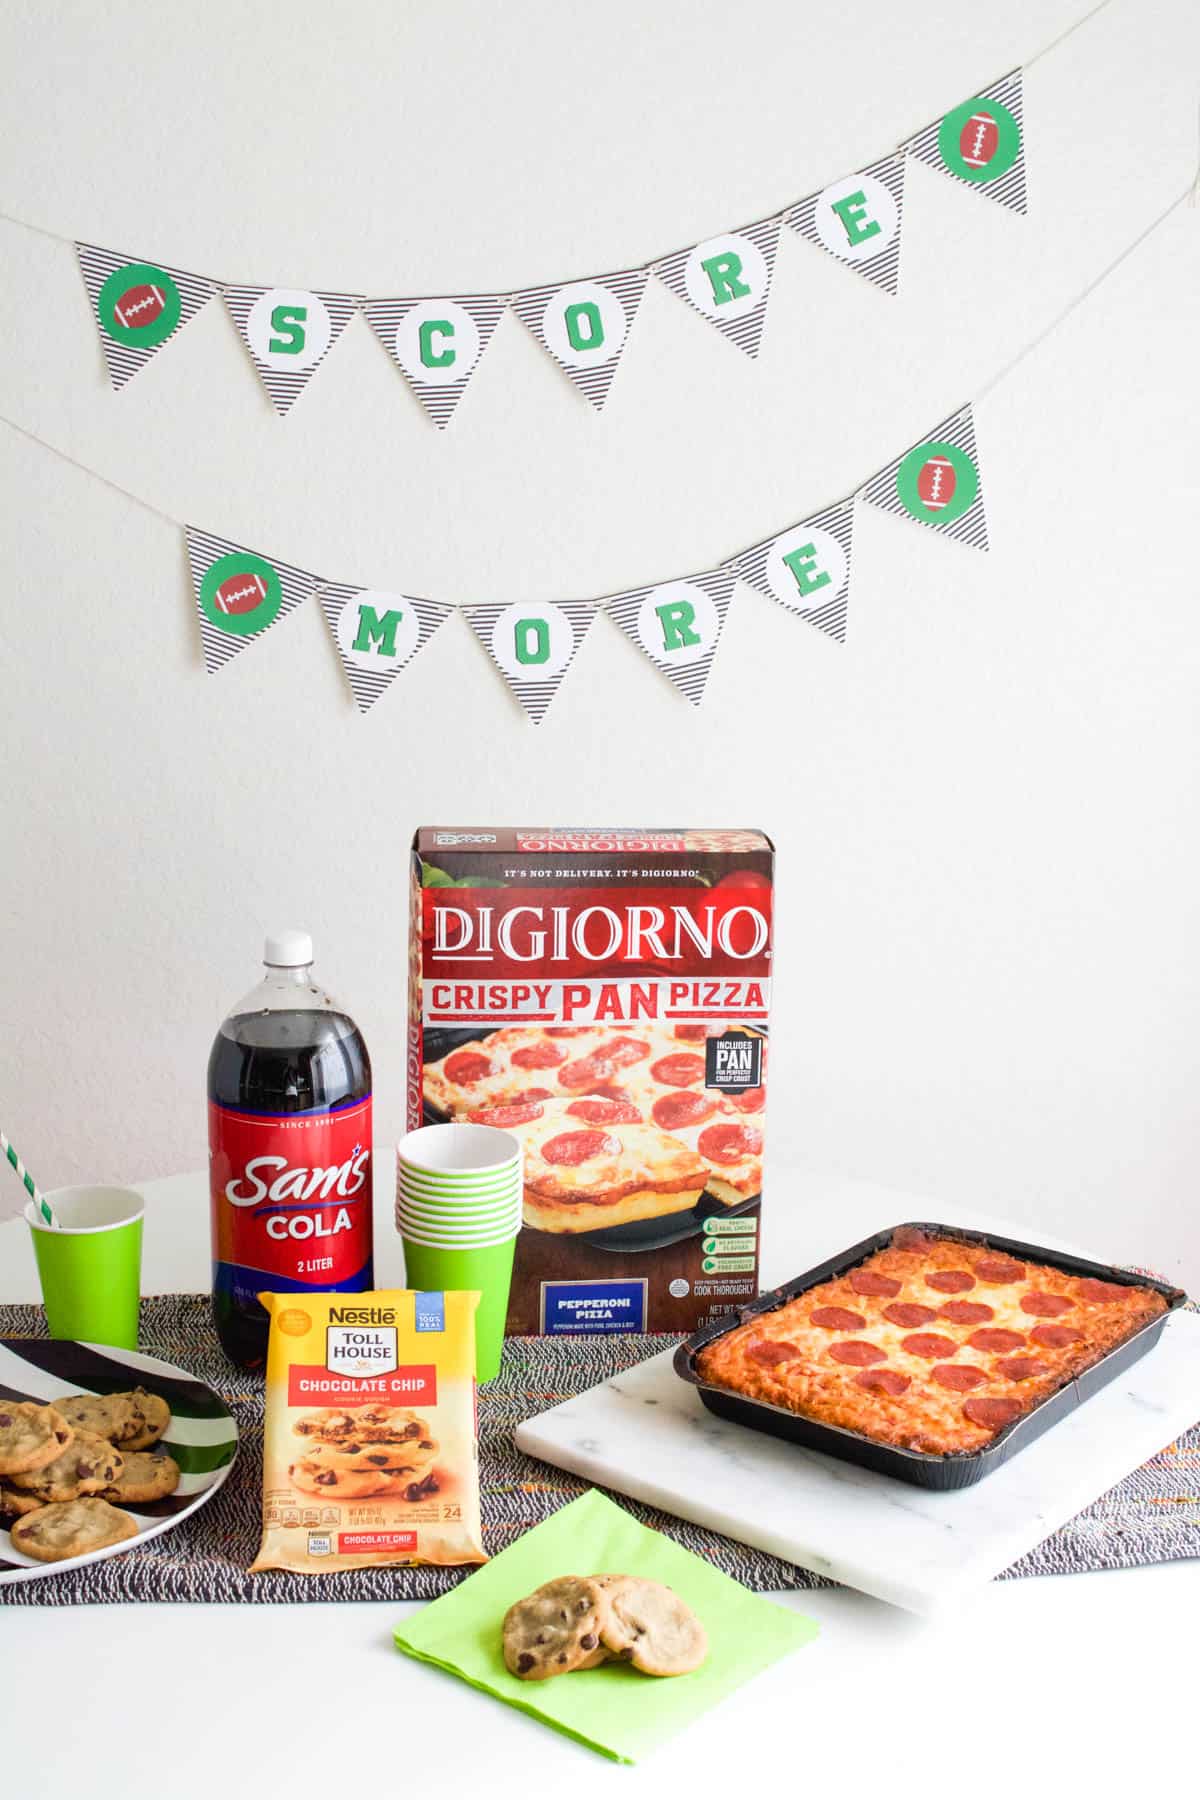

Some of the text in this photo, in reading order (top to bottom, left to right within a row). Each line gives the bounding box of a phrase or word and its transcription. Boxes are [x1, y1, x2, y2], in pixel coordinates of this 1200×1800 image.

[504, 869, 527, 878] IT'S
[530, 869, 552, 878] NOT
[555, 869, 614, 878] DELIVERY.
[616, 869, 638, 878] IT'S
[432, 983, 765, 1021] CRISPY PAN PIZZA
[716, 1041, 753, 1050] INCLUDES
[716, 1050, 753, 1070] PAN
[279, 1121, 311, 1129] SINCE
[225, 1146, 369, 1207] Sam's
[266, 1208, 352, 1240] COLA
[297, 1257, 333, 1272] 2 LITER
[694, 1285, 711, 1297] COOK
[713, 1284, 753, 1296] THOROUGHLY
[558, 1298, 631, 1310] PEPPERONI
[709, 1304, 722, 1315] NET
[576, 1310, 613, 1319] PIZZA
[343, 1333, 383, 1345] TOLL
[334, 1347, 392, 1359] HOUSE
[300, 1379, 425, 1392] CHOCOLATE CHIP
[443, 1507, 461, 1518] 24
[344, 1534, 412, 1545] CHOCOLATE CHIP
